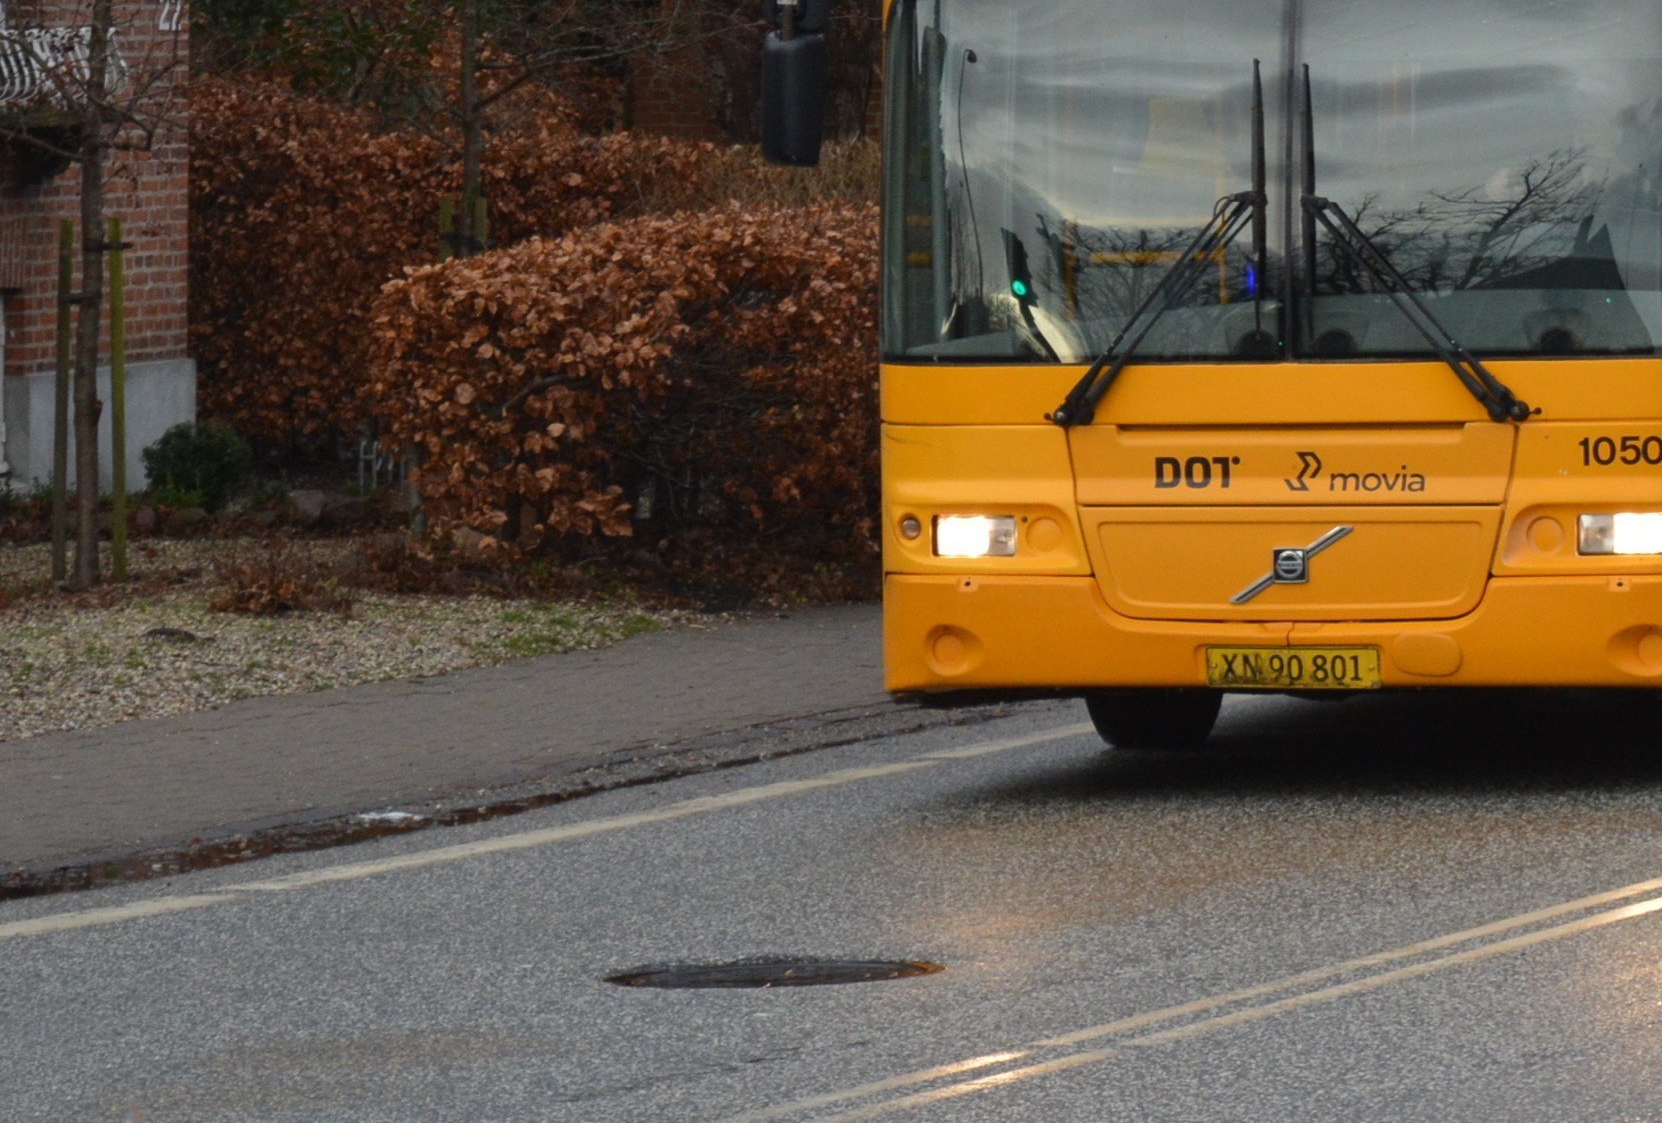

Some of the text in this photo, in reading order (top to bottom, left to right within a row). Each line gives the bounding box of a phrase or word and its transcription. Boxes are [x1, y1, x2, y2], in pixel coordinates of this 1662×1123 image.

[1154, 456, 1240, 489] DOT
[1329, 465, 1425, 492] movia
[1222, 654, 1362, 682] XN 90 801
